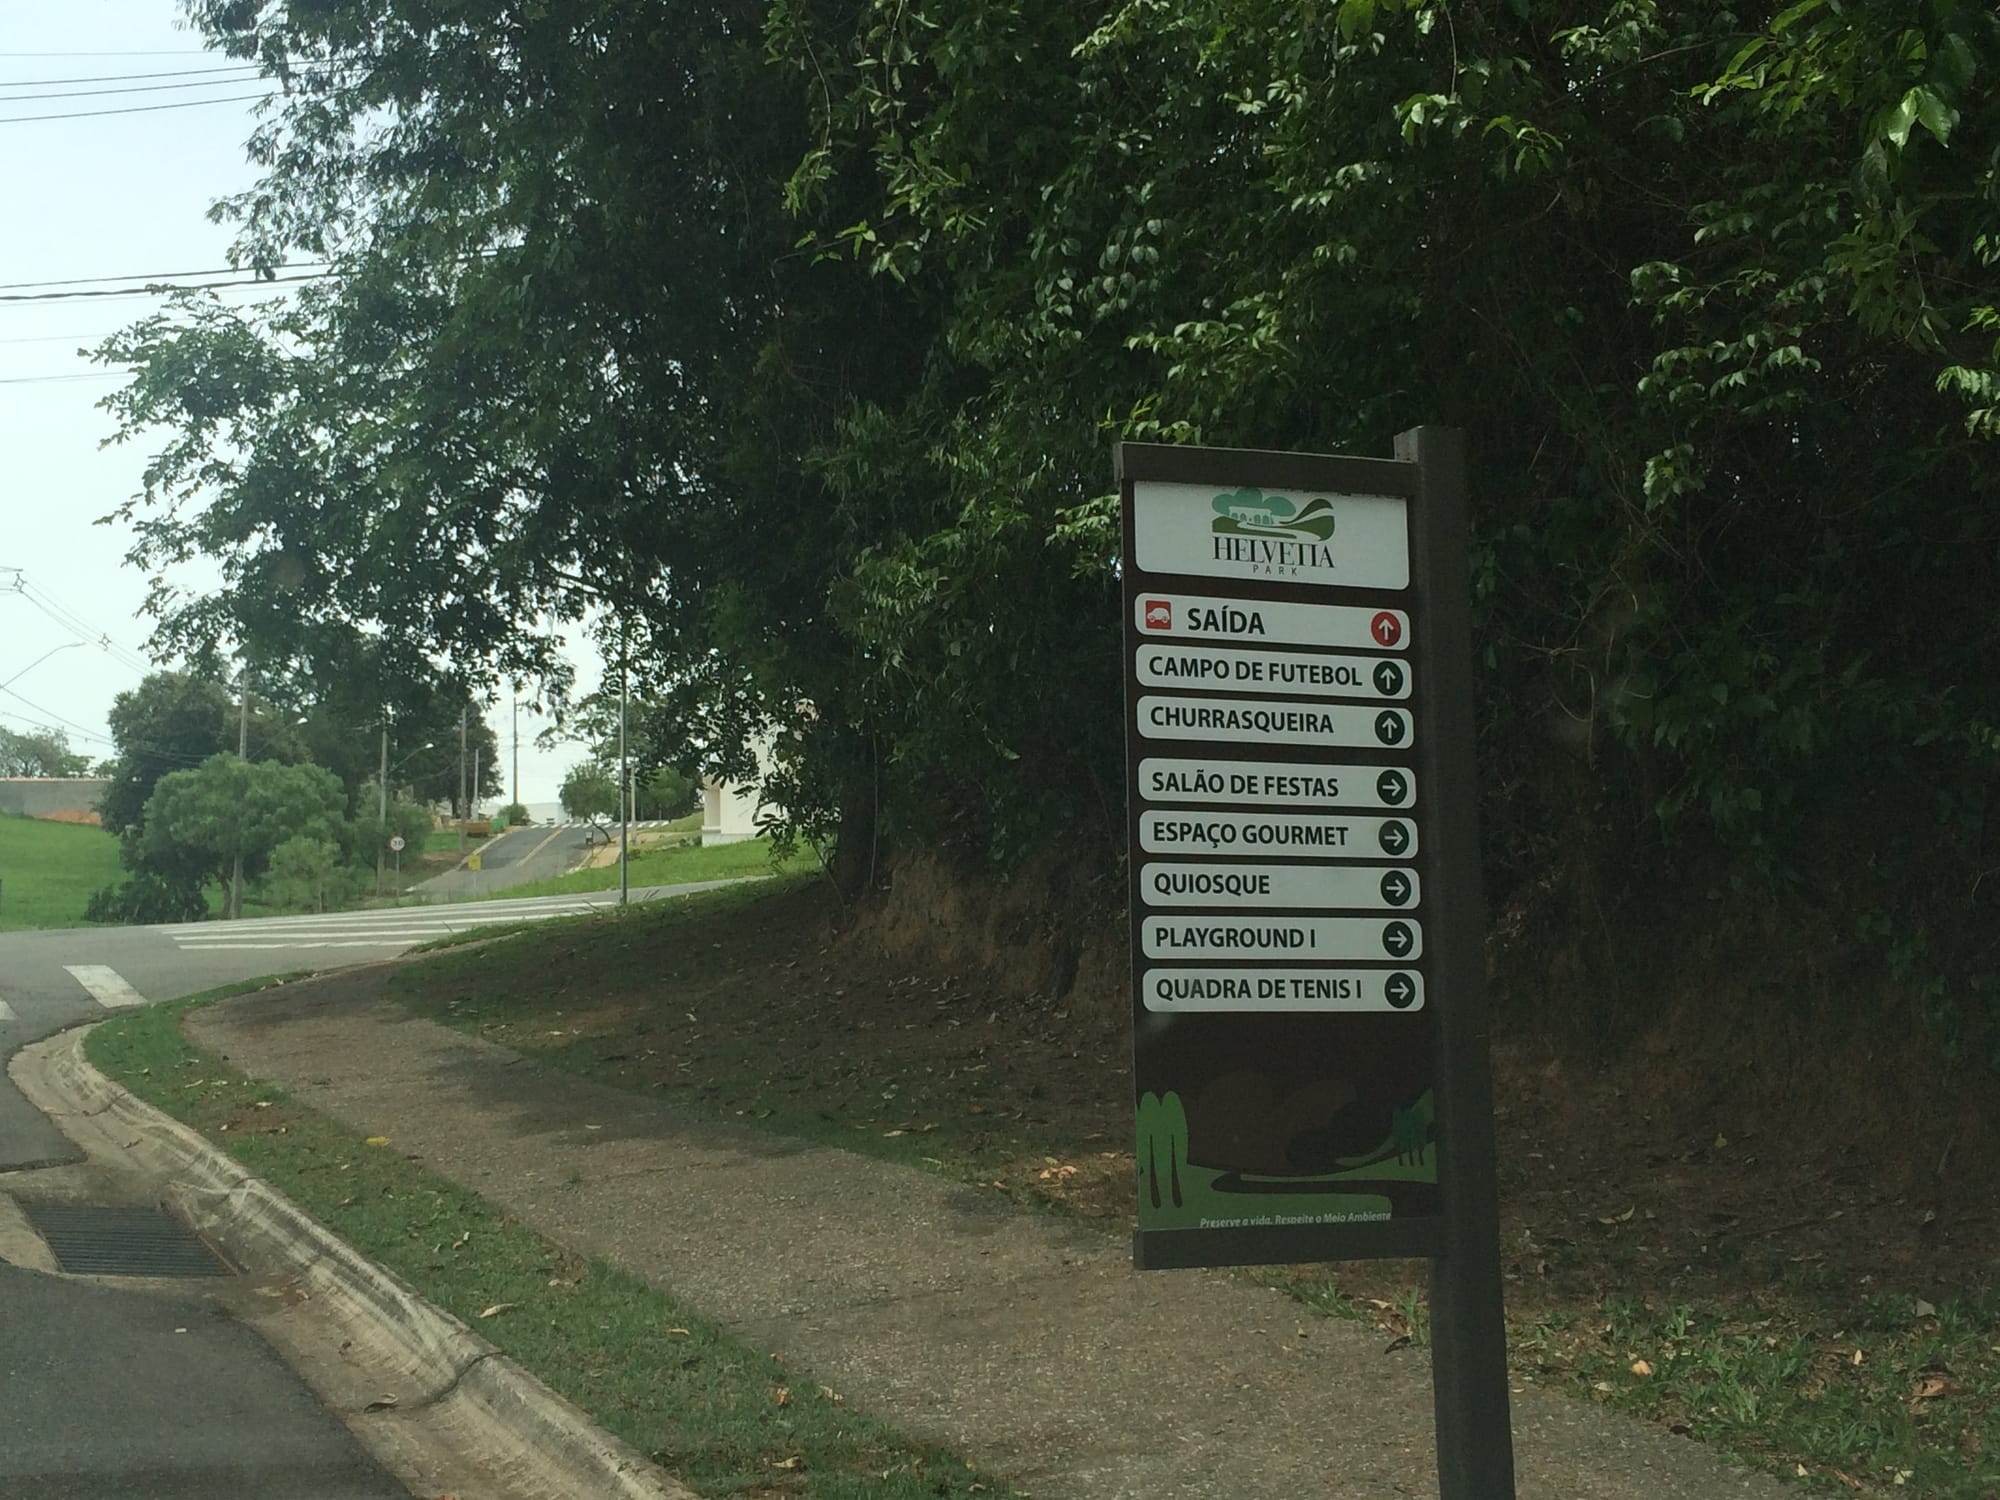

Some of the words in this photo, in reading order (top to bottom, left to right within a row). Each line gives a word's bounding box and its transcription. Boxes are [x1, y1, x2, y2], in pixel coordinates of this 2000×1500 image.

[1212, 536, 1335, 568] HELVETIA
[1253, 564, 1298, 577] PARK
[1187, 605, 1265, 635] SAÍDA
[1149, 655, 1230, 680] CAMPO
[1235, 661, 1263, 681] DE
[1268, 662, 1363, 687] FUTEBOL
[1150, 706, 1335, 734] CHURRASQUEIRA
[1152, 768, 1225, 794] SALÃO
[1230, 774, 1259, 795] DE
[1264, 775, 1339, 797] FESTAS
[1153, 821, 1237, 848] ESPAÇO
[1242, 824, 1349, 846] GOURMET
[1154, 873, 1271, 896] QUIOSQUE
[1155, 927, 1305, 948] PLAYGROUND
[1310, 929, 1315, 948] I
[1156, 978, 1252, 1001] QUADRA
[1257, 979, 1287, 999] DE
[1290, 979, 1351, 999] TENIS
[1356, 979, 1362, 999] I
[1200, 1217, 1241, 1228] Preserve
[1242, 1217, 1250, 1226] a
[1251, 1215, 1273, 1225] vida.
[1275, 1214, 1314, 1226] Respeite
[1316, 1215, 1322, 1223] o
[1323, 1212, 1346, 1222] Meio
[1347, 1211, 1391, 1222] Ambiente
